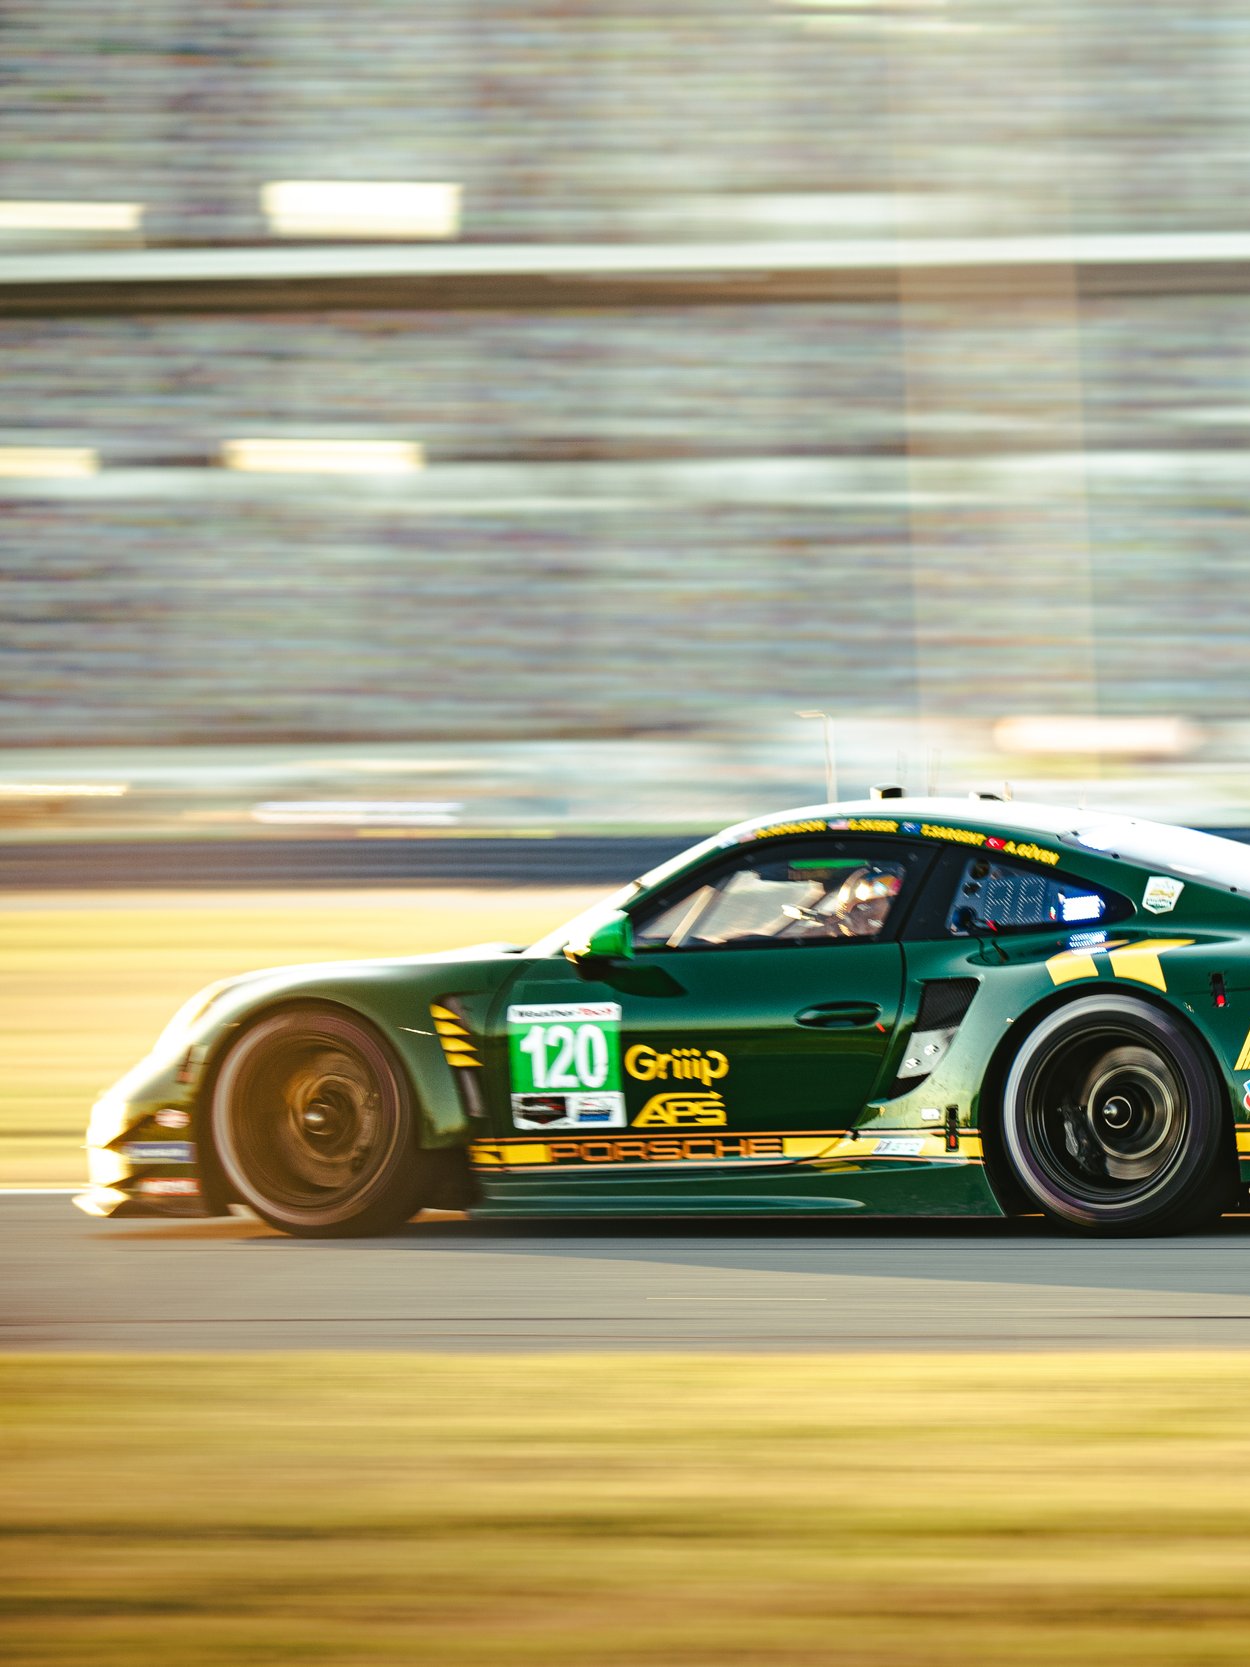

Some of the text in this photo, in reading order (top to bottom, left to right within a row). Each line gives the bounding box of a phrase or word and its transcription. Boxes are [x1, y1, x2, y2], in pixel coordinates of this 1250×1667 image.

[519, 1023, 609, 1088] 120
[624, 1044, 730, 1087] Griiip
[630, 1090, 728, 1128] APS
[549, 1137, 784, 1163] PORSCHE
